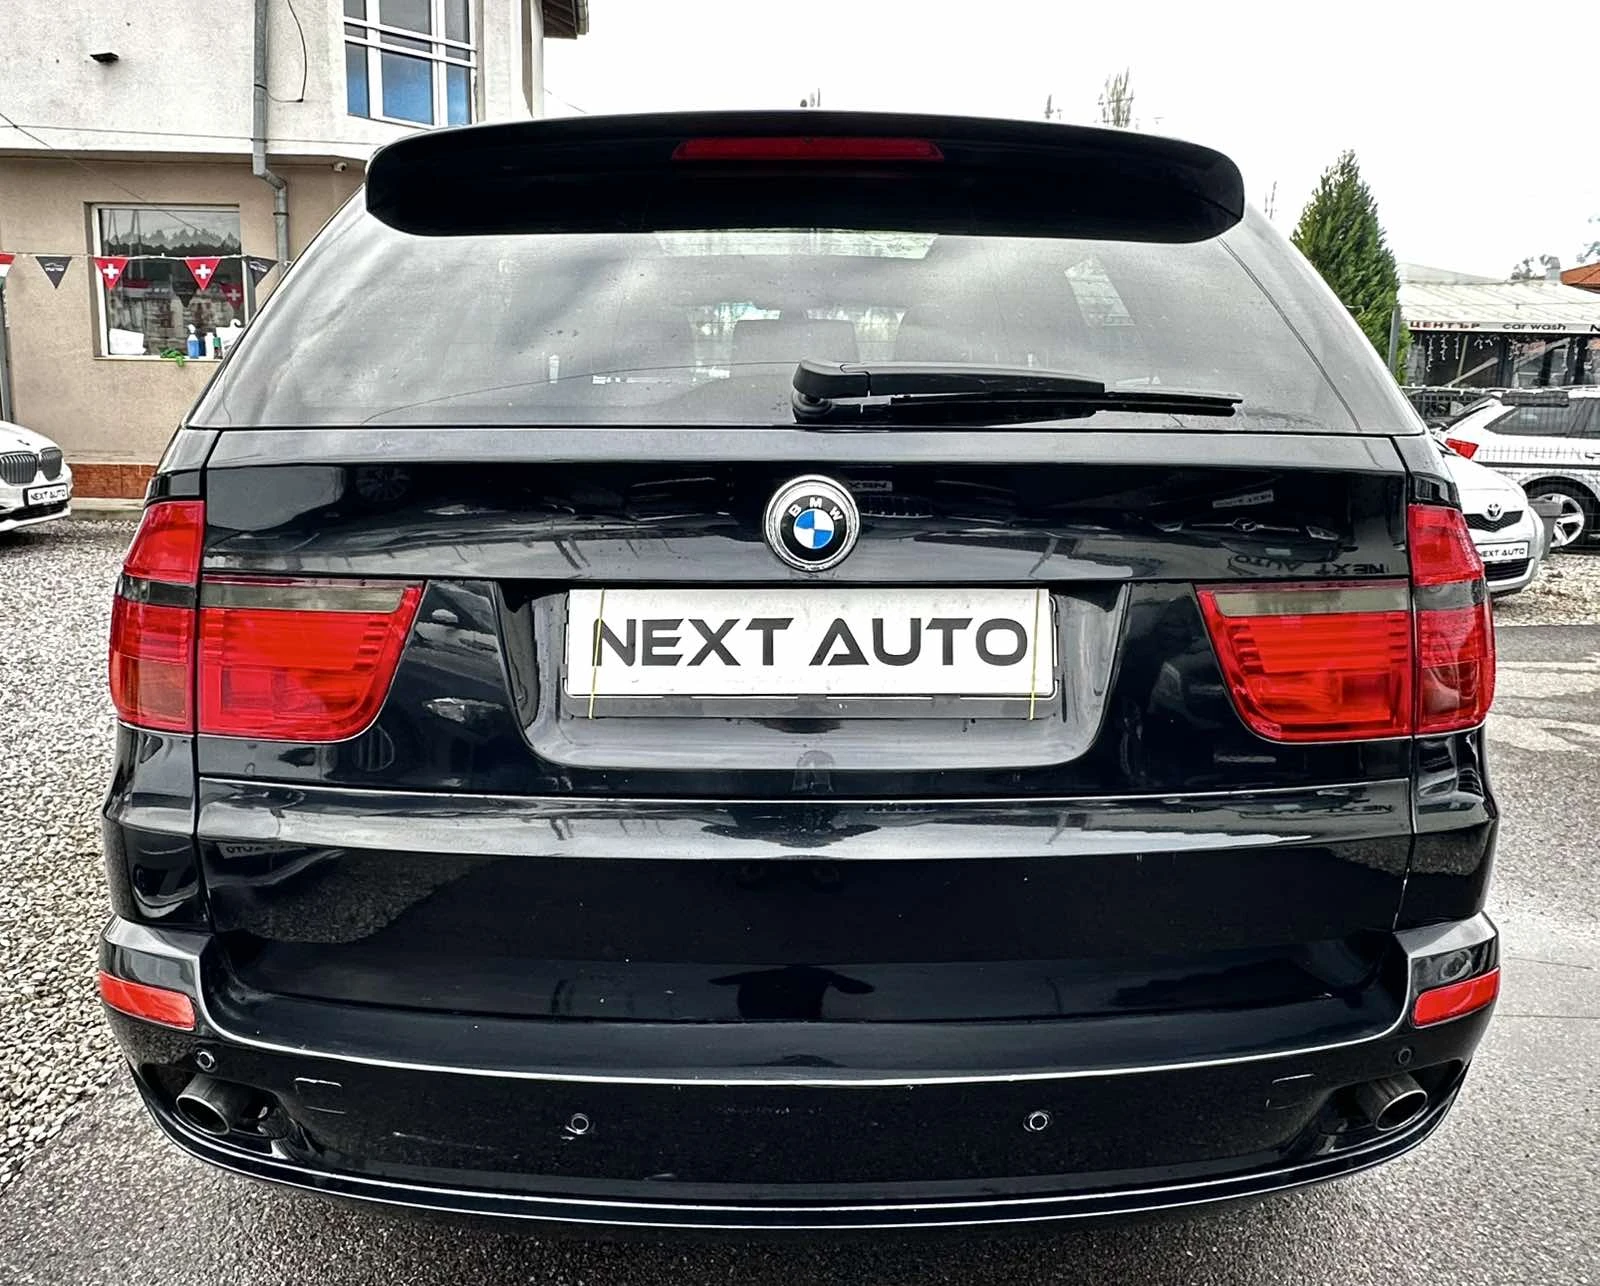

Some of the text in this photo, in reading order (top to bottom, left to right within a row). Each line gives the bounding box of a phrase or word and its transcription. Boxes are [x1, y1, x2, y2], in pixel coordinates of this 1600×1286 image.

[1409, 321, 1480, 330] ЦЕНТЪР
[31, 489, 65, 501] NEXT AUTO
[788, 497, 843, 521] BMW
[1502, 548, 1525, 556] AUTO
[592, 617, 1028, 667] NEXT AUTO
